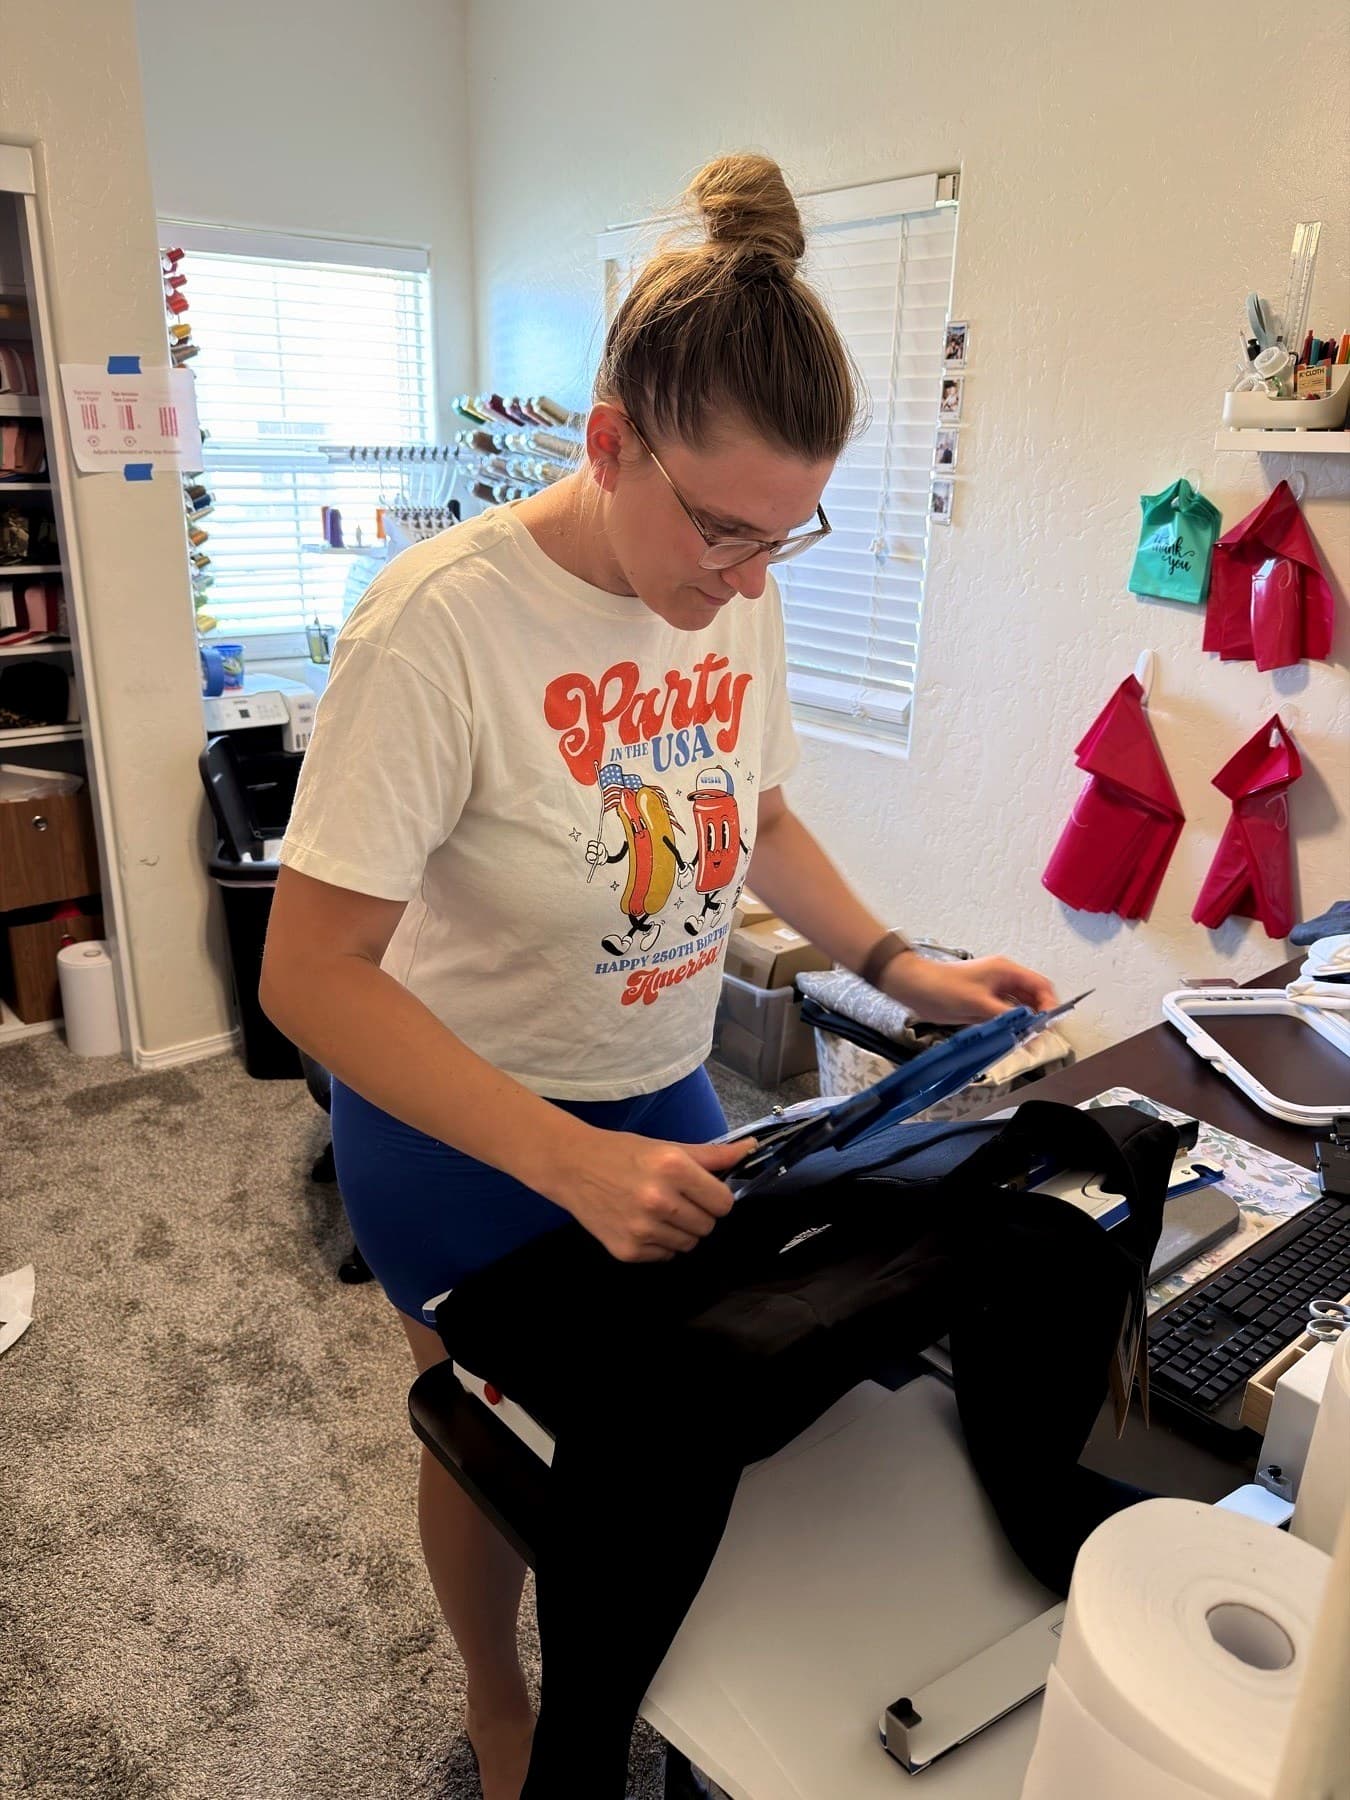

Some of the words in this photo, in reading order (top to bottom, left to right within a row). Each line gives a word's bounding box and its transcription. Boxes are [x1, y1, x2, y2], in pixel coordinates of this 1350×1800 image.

[1162, 555, 1192, 575] you
[544, 653, 753, 786] Party
[610, 747, 622, 761] IN
[624, 742, 648, 759] THE
[651, 725, 715, 772] USA
[595, 955, 650, 974] HAPPY
[652, 942, 693, 964] 250TH
